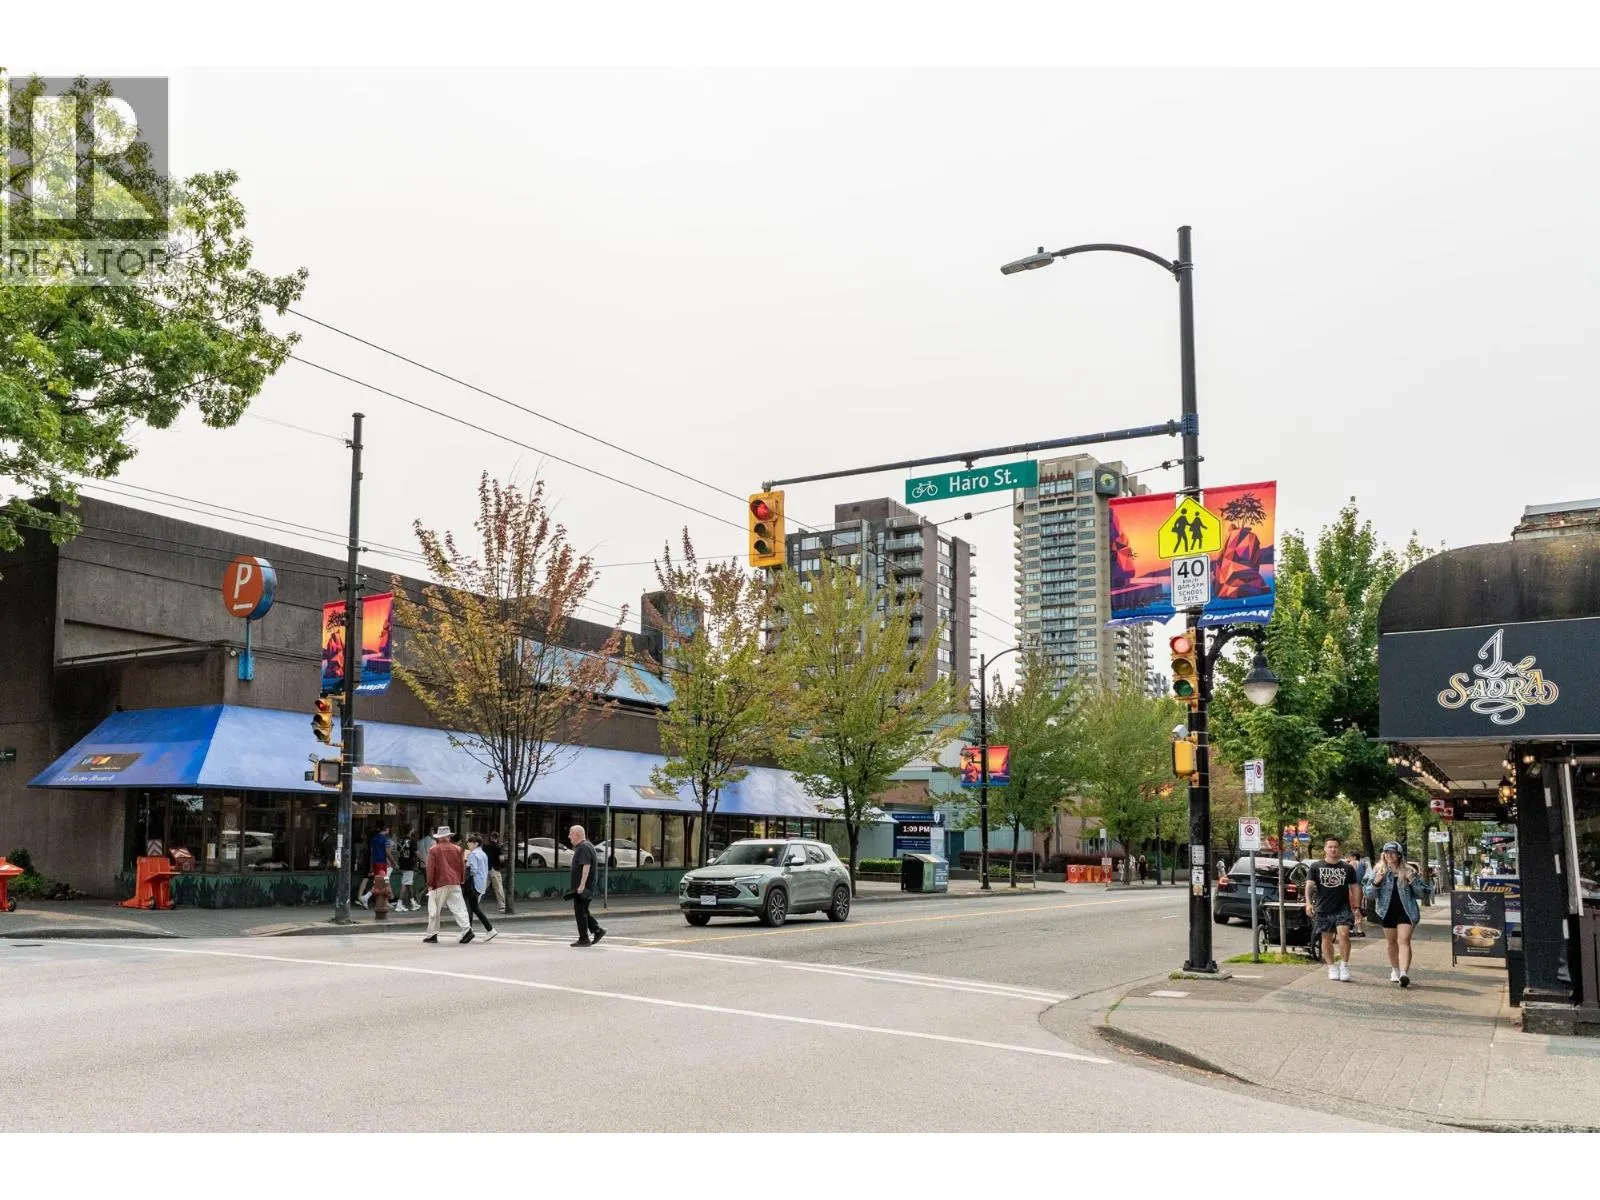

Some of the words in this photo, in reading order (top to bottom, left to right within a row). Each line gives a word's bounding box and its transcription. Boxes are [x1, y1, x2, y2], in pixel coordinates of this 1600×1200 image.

[949, 474, 989, 493] Haro
[994, 468, 1018, 486] St.
[1177, 559, 1205, 579] 40
[1178, 588, 1203, 597] SCHOOL
[1202, 609, 1270, 621] DENMAN
[902, 825, 918, 833] 1:09
[919, 825, 931, 833] PM
